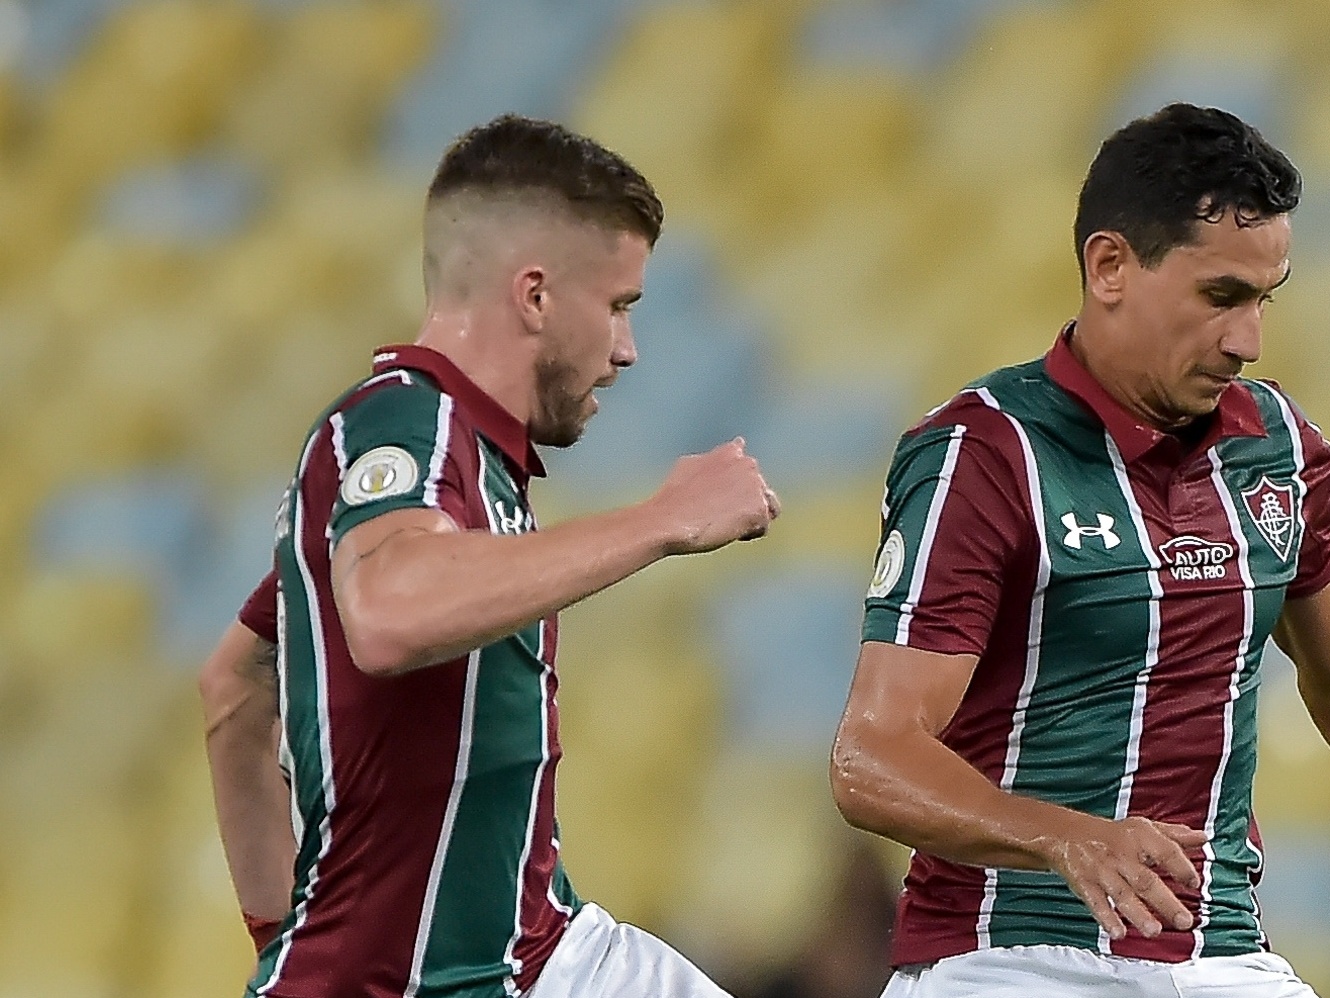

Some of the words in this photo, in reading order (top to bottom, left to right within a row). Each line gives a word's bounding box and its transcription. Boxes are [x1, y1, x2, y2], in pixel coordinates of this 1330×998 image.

[1175, 547, 1227, 566] AUTO
[1170, 566, 1203, 580] VISA
[1203, 564, 1226, 580] RIO
